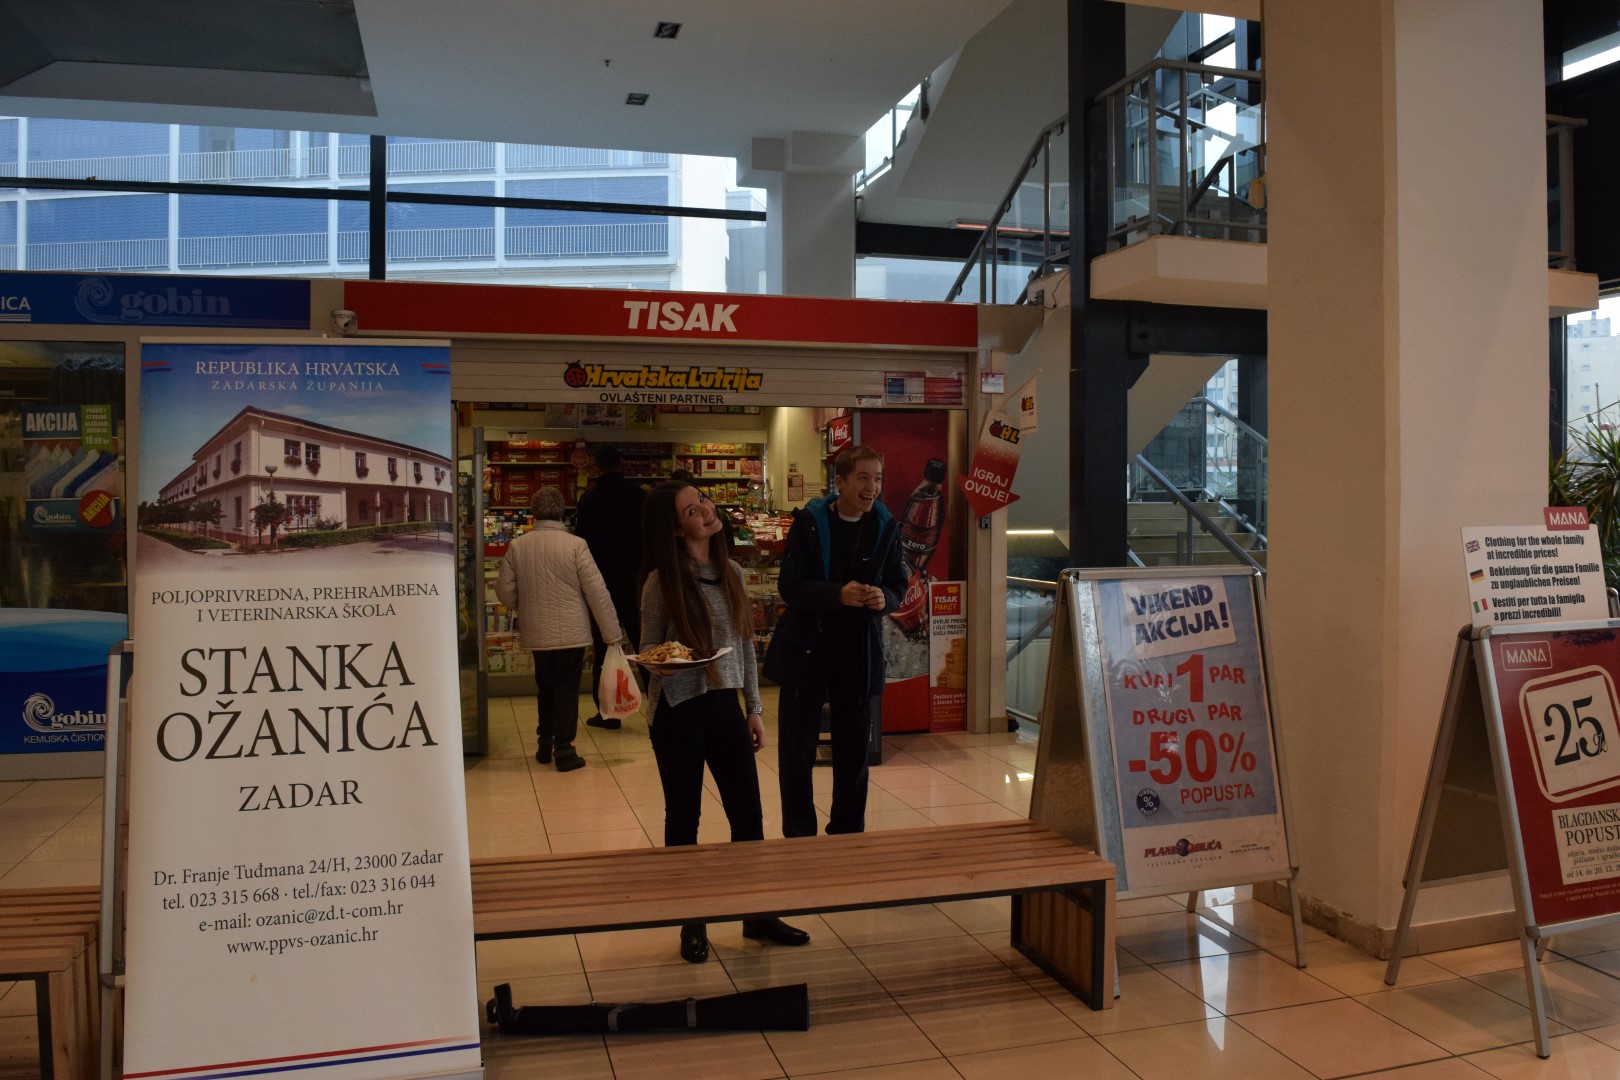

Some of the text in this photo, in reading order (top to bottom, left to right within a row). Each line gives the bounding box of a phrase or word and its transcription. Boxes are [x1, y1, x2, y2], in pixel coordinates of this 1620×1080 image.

[120, 287, 232, 322] gobin
[622, 300, 741, 333] TISAK
[195, 361, 400, 376] REPUBLIKA HRVATSKA
[212, 380, 384, 391] ZADARSKA ŽUPANIJA
[599, 391, 724, 404] OVLAŠTENI PARTNER
[26, 412, 78, 432] AKCIJA
[973, 467, 1009, 488] IGRAJ
[964, 479, 1010, 504] OVDJE!
[82, 493, 111, 522] AKCIJA
[1549, 512, 1587, 526] MANA
[907, 540, 926, 550] zero
[1485, 534, 1585, 548] Clothing for the whole family
[1486, 548, 1559, 560] at incredible prices!
[1489, 562, 1600, 577] Bekleidung für die ganze Familie
[151, 582, 440, 605] POLJOPRIVREDNA, PREHRAMBENA
[1491, 575, 1581, 590] zu unglaublichen Preisen!
[934, 595, 958, 603] TISAK
[934, 603, 958, 611] PAKET
[1130, 584, 1213, 616] VIKEND
[1492, 593, 1585, 609] Vestiti per tutta la famiglia
[197, 601, 397, 623] I VETERINARSKA ŠKOLA
[1494, 606, 1562, 621] a prezzi incredibili!
[1135, 602, 1230, 646] AKCIJA!
[1506, 648, 1547, 664] MANA
[179, 640, 416, 698] STANKA
[1176, 653, 1204, 703] 1
[1208, 664, 1246, 685] PAR
[1132, 702, 1243, 726] DRUGI PAR
[156, 691, 439, 762] OŽANIĆA
[23, 734, 70, 744] KEMIJSKA
[1128, 729, 1257, 785] -50%
[238, 779, 364, 813] ZADAR
[1180, 783, 1255, 805] POPUSTA
[153, 849, 444, 887] Dr. Franje Tuđmana 24/H, 23000 Zadar
[162, 873, 437, 910] tel. 023 315 668 tel./fax: 023 316 044
[198, 900, 404, 933] e-mail: ozanic@zd.t-com.hr
[226, 927, 379, 956] www.ppvs-ozanic.hr
